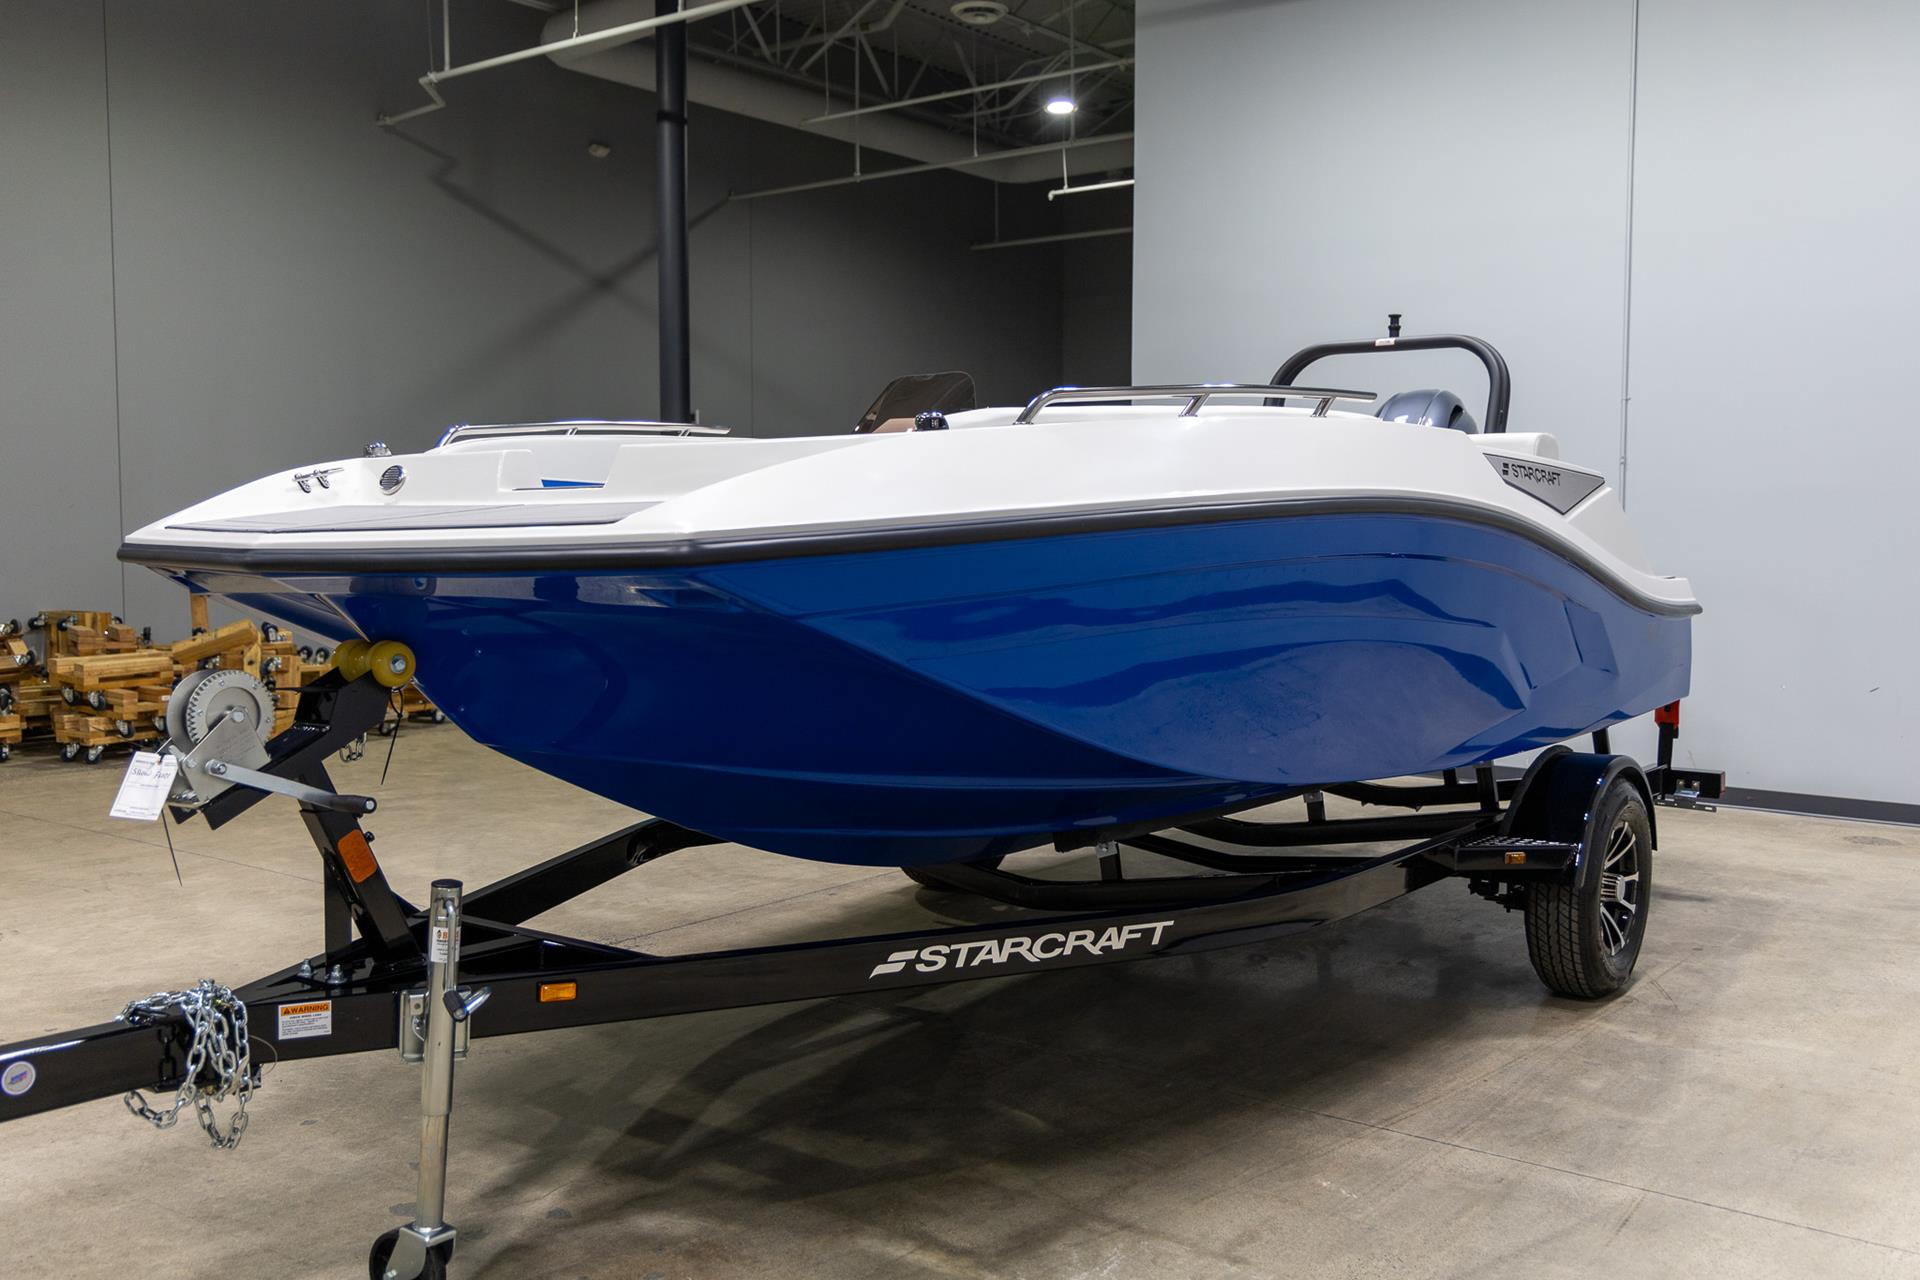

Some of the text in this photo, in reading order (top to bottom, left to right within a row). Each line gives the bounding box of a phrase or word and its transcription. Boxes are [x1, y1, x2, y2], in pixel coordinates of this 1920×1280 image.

[1511, 464, 1561, 486] STARCRAFT
[915, 920, 1175, 973] STARCRAFT
[290, 1003, 329, 1014] WARNING
